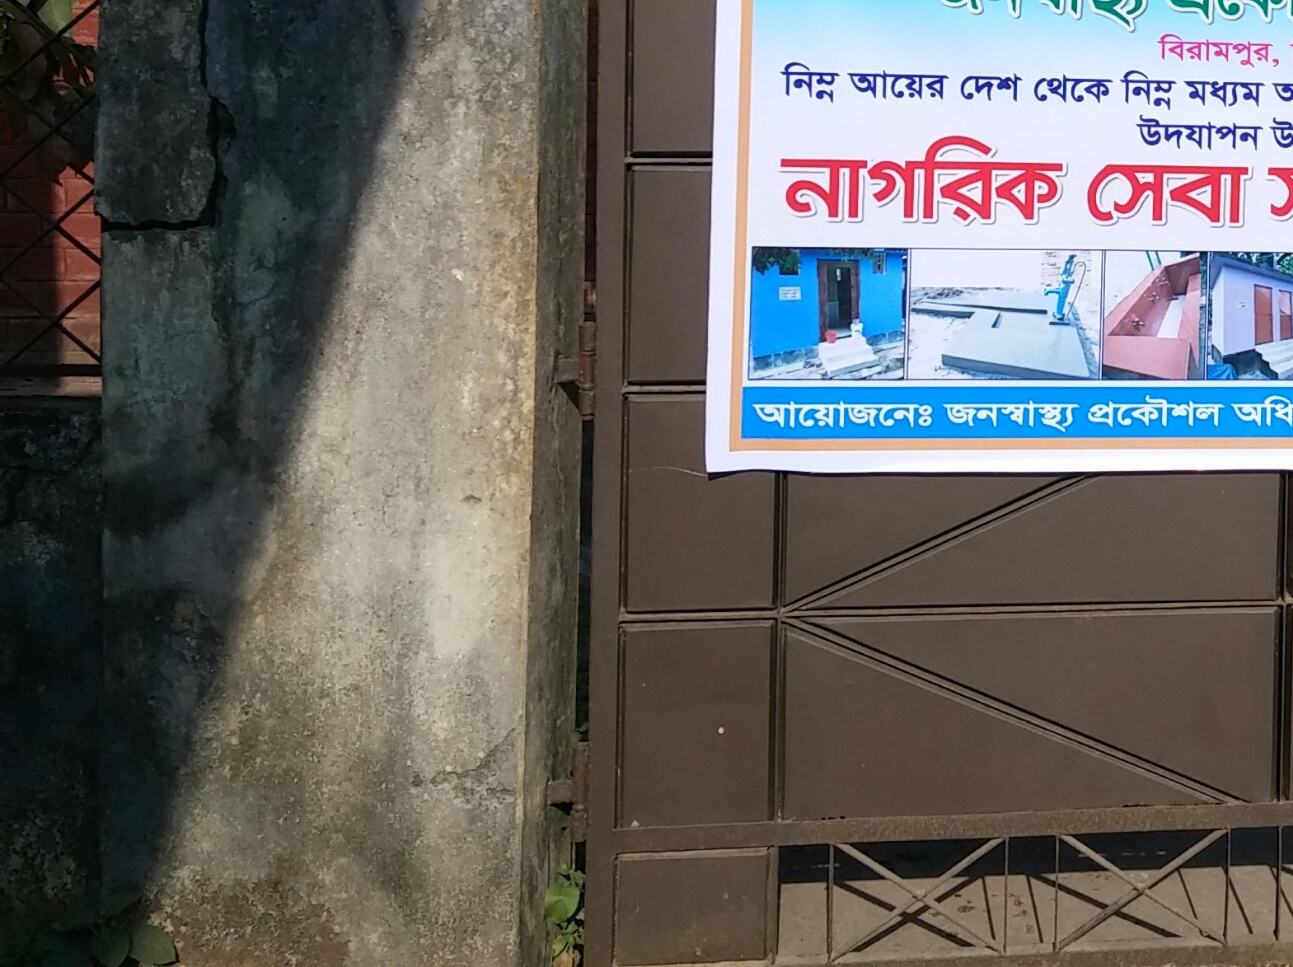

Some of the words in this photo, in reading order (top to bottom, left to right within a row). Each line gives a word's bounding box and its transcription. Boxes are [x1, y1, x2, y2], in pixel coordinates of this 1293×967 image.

[1158, 34, 1279, 68] বিরামপুর,
[781, 62, 840, 103] নিম্ন
[849, 69, 949, 101] আয়ের
[960, 73, 1022, 103] দেশ
[1033, 76, 1112, 104] থেকে
[1120, 70, 1177, 110] নিম্ন
[1183, 80, 1265, 107] মধ্যম
[1135, 115, 1263, 151] উদযাপন
[780, 134, 1064, 222] নাগরিক
[1086, 163, 1250, 224] সেবা
[943, 399, 1081, 433] জনস্বাস্থ্য
[1088, 395, 1223, 428] প্রকৌশল
